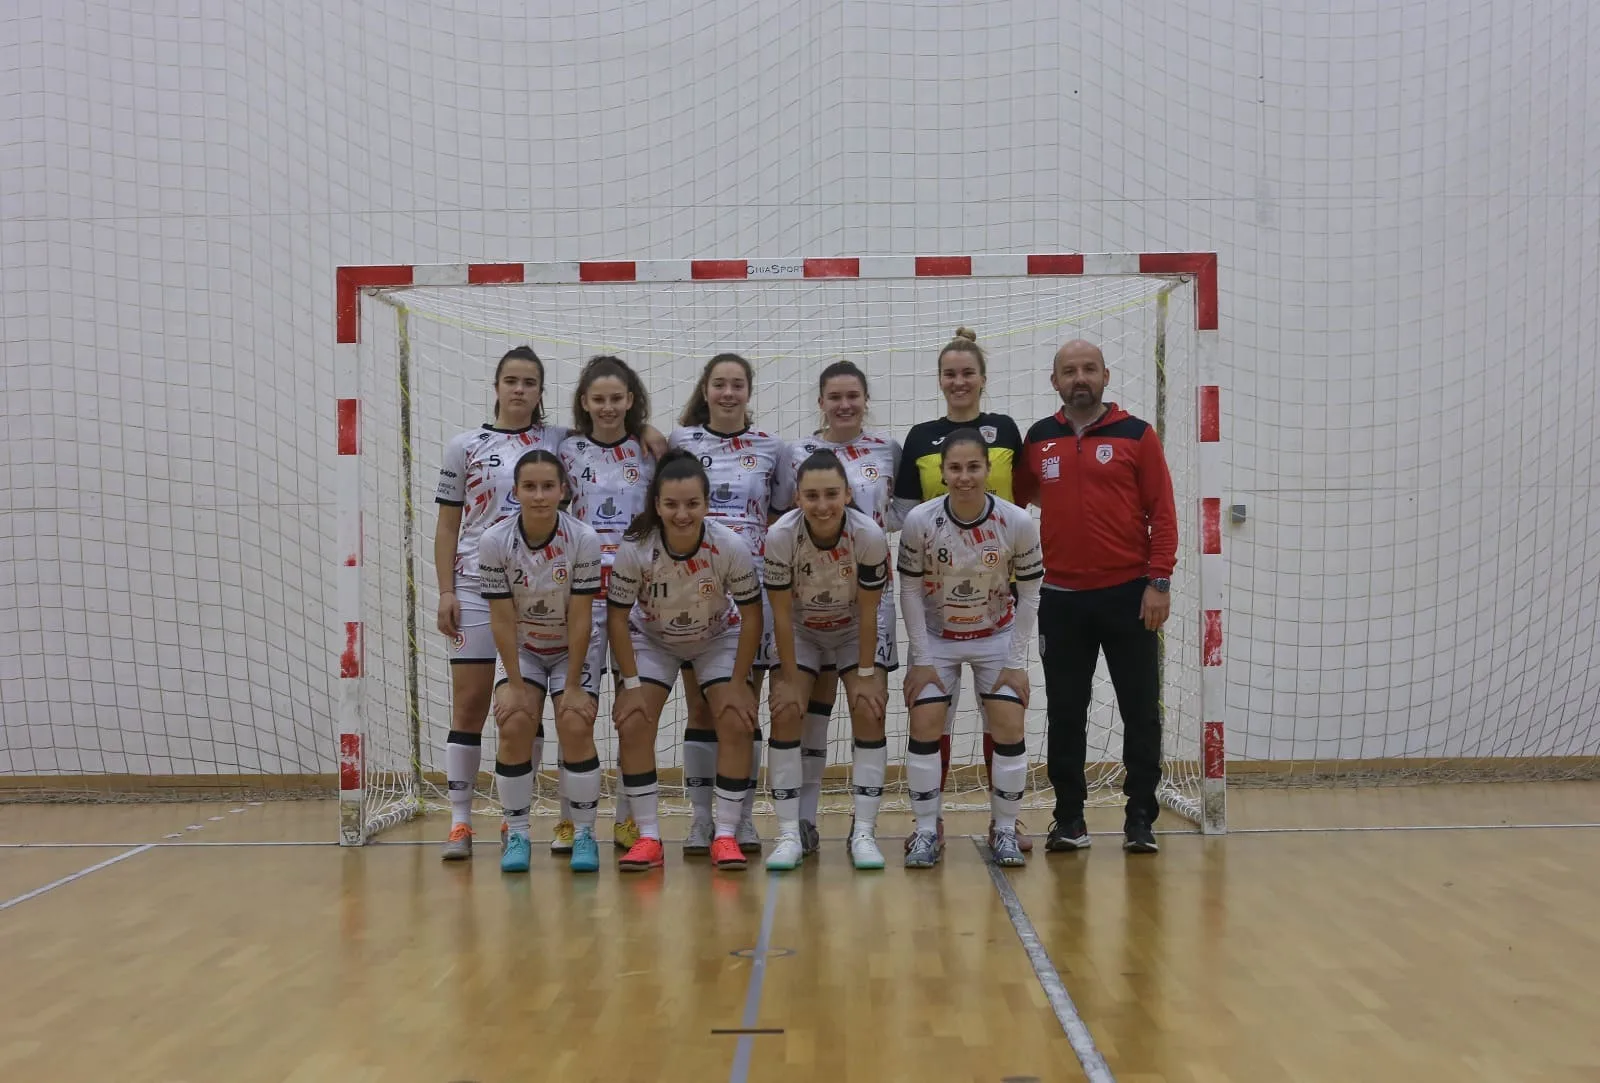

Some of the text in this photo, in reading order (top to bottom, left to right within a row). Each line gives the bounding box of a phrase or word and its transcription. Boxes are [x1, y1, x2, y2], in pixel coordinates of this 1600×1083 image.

[489, 454, 501, 467] 5
[581, 467, 592, 481] 4
[938, 548, 949, 563] 8
[513, 569, 524, 584] 2
[651, 582, 667, 598] 11
